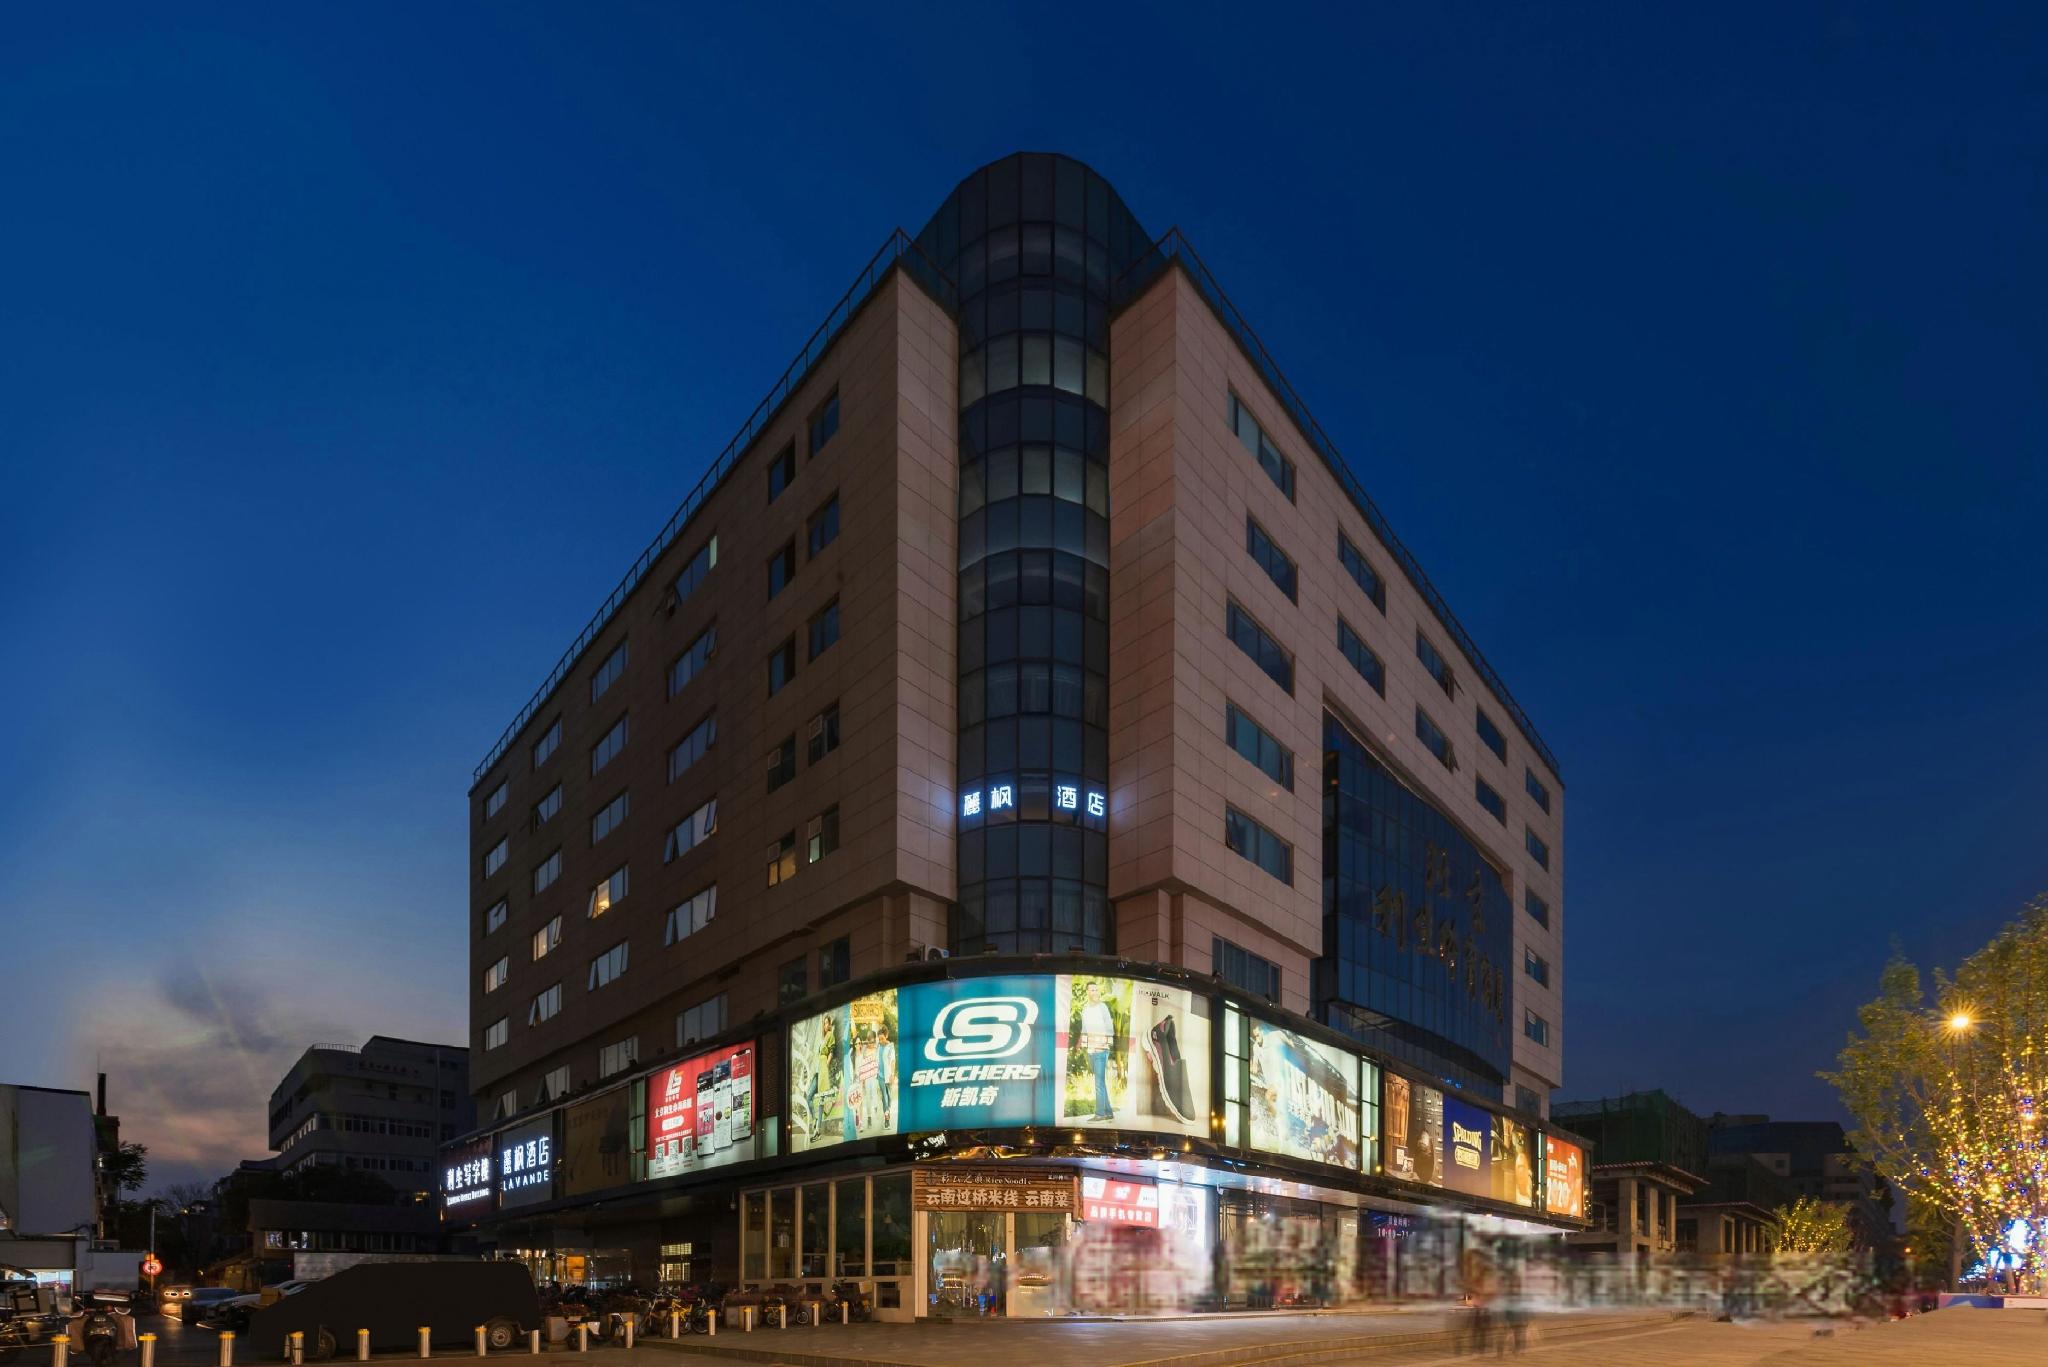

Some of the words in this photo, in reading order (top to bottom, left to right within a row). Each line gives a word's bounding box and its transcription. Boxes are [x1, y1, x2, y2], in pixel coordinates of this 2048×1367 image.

[910, 1064, 1041, 1087] SKECHERS
[941, 1086, 999, 1107] 斯凯奇
[1453, 1121, 1482, 1152] SPALDING
[503, 1170, 549, 1191] LAVANDE
[926, 1188, 1018, 1207] 云南过桥米线
[1025, 1190, 1069, 1207] 云南菜
